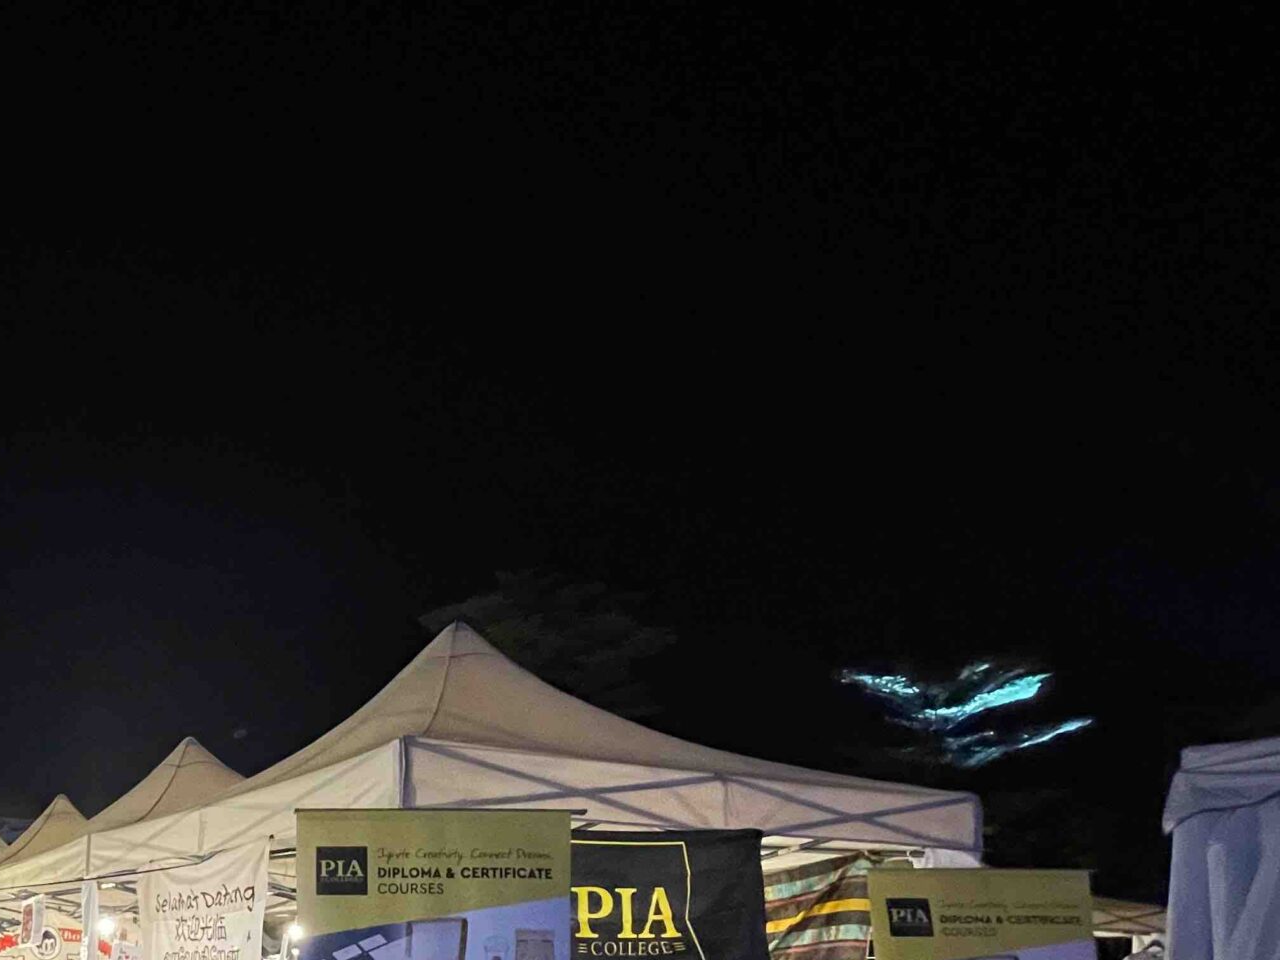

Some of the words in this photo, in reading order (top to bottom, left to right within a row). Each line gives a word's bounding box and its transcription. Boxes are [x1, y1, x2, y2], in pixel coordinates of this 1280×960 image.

[320, 859, 364, 877] PIA
[377, 867, 441, 879] DIPLOMA
[446, 867, 455, 879] &
[461, 867, 553, 880] CERTIFICATE
[377, 882, 444, 895] COURSES
[570, 886, 682, 938] PIA
[890, 907, 929, 924] PIA
[939, 915, 993, 925] DIPLOMA
[590, 941, 674, 957] COLLEGE
